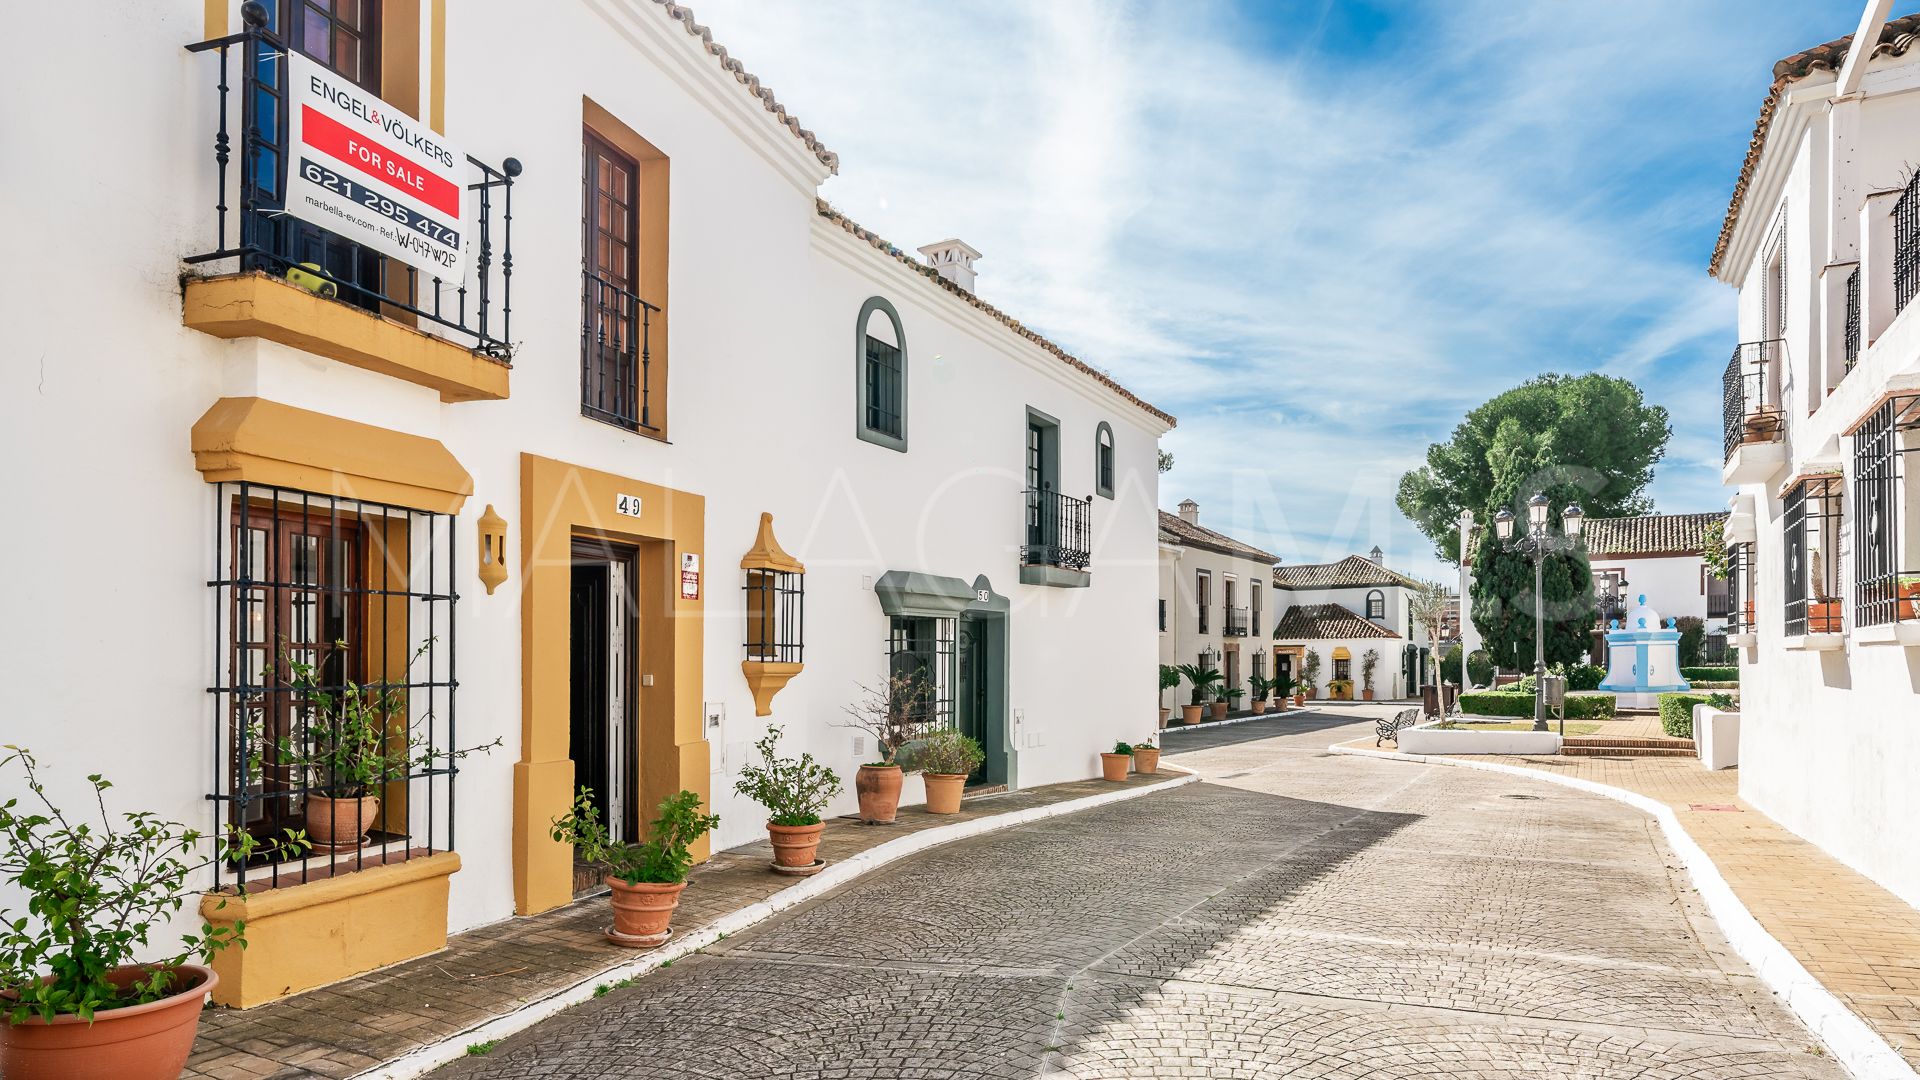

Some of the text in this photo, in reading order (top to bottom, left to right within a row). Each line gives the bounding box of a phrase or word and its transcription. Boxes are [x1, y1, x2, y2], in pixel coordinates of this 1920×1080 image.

[348, 140, 425, 191] FOR SALE
[305, 164, 457, 248] 621 295 474
[305, 195, 375, 232] marbella-ev.com
[619, 497, 640, 515] 49
[978, 590, 988, 601] 50
